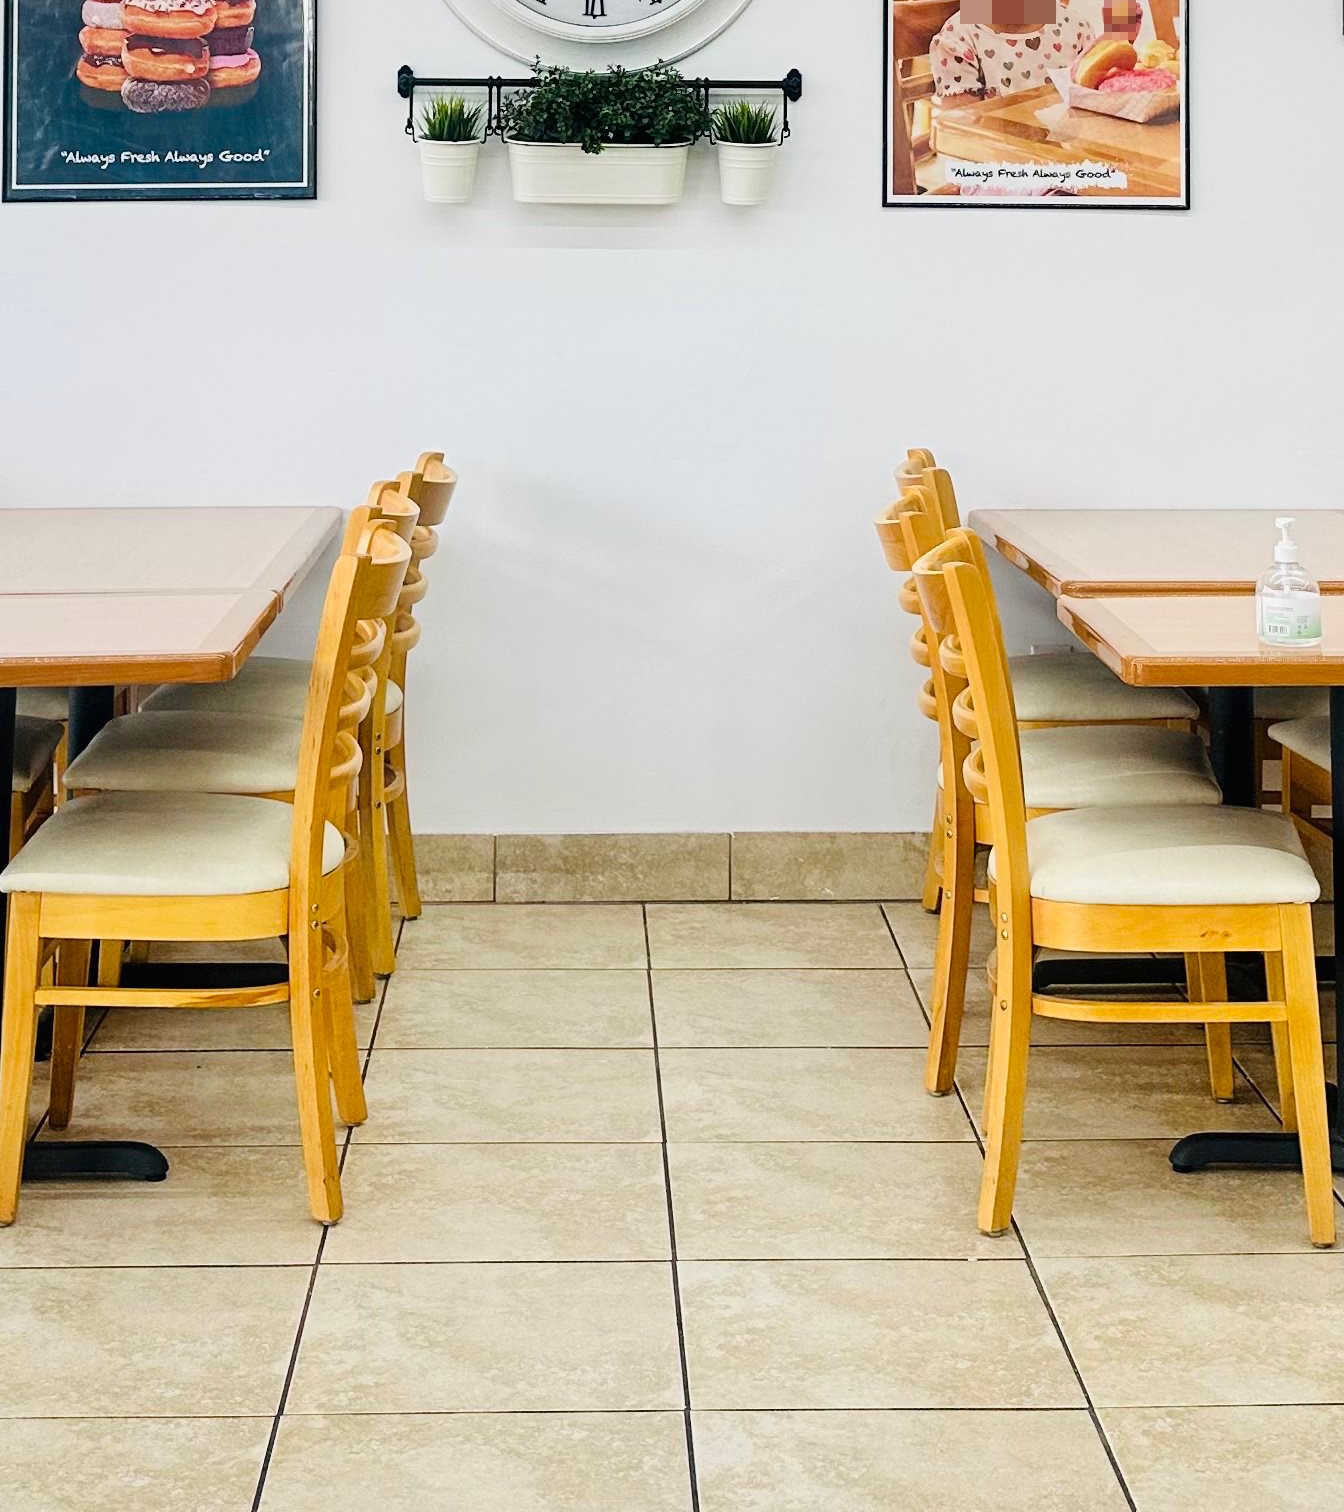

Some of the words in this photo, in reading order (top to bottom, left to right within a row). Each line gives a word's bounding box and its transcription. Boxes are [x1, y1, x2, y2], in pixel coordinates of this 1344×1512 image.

[120, 151, 160, 164] Fresh
[164, 151, 214, 169] Always
[998, 168, 1028, 178] Fresh
[1032, 168, 1071, 183] Always
